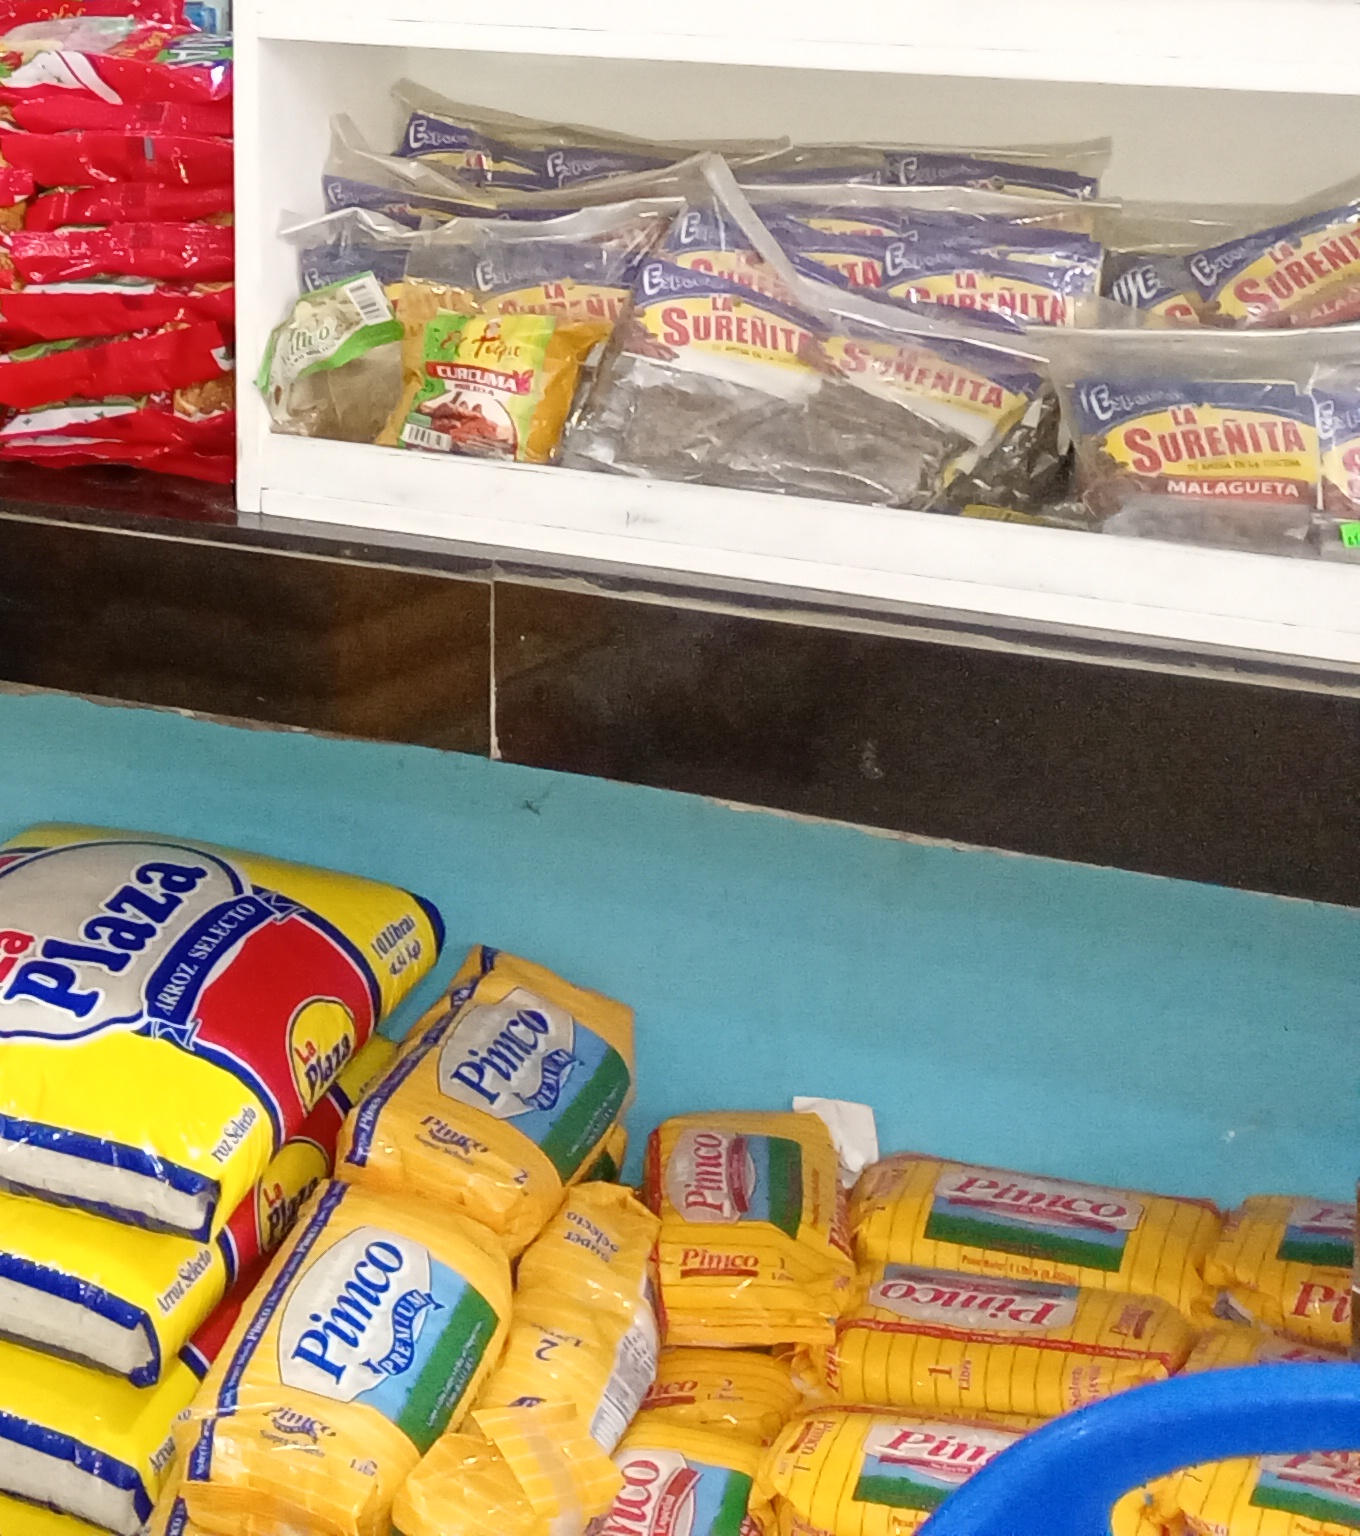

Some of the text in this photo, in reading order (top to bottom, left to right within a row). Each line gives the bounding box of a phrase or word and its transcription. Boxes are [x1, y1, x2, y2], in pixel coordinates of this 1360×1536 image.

[1269, 240, 1294, 266] LA
[955, 270, 977, 289] LA
[710, 292, 734, 312] LA
[437, 365, 518, 392] CURCUMA
[1171, 406, 1197, 426] LA
[1123, 418, 1307, 474] SUREÑITA
[1167, 480, 1299, 498] MALAGUETA
[5, 859, 209, 1021] Plaza
[154, 902, 257, 1016] ARROZ SELECTO
[294, 1039, 317, 1064] La
[304, 1032, 354, 1100] Plaza
[449, 1007, 551, 1104] Pimco
[226, 1105, 258, 1149] Selecto
[262, 1180, 284, 1208] La
[684, 1133, 727, 1218] Pimco
[953, 1176, 1129, 1219] Pimco
[155, 1247, 214, 1317] Arroz Selecto
[680, 1249, 760, 1271] Pimco
[292, 1239, 405, 1384] Pimco
[880, 1280, 1065, 1326] Pimco
[383, 1291, 428, 1375] PREMIUM
